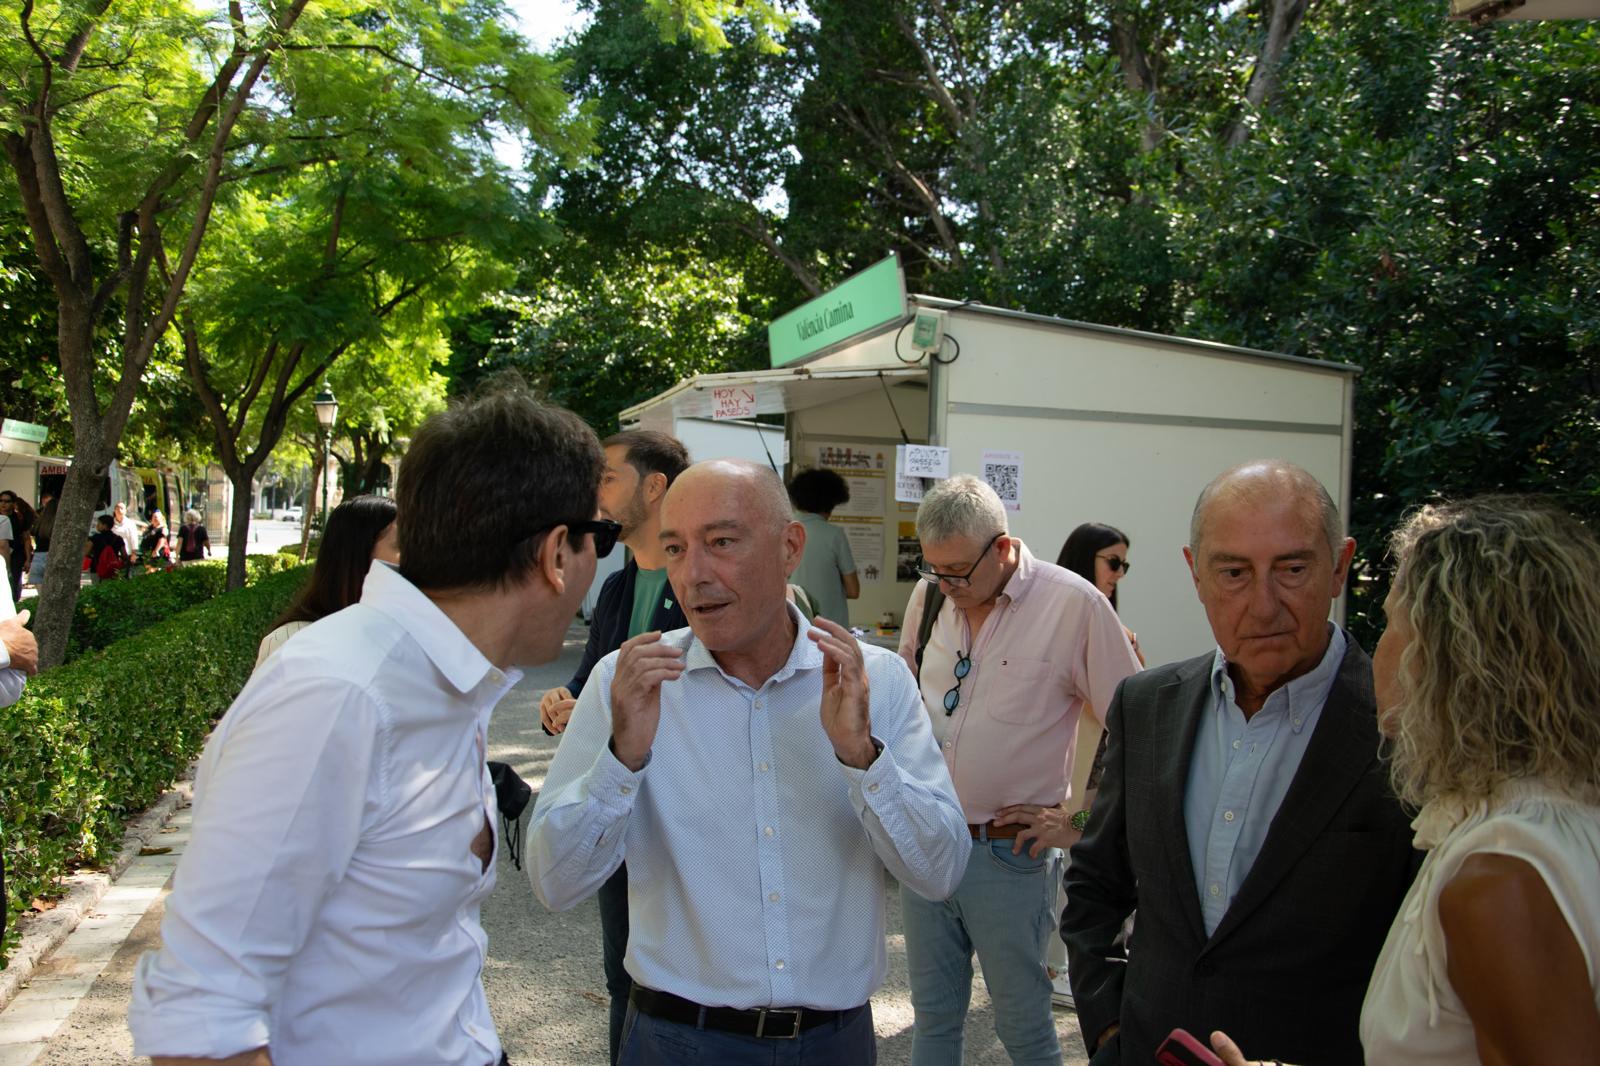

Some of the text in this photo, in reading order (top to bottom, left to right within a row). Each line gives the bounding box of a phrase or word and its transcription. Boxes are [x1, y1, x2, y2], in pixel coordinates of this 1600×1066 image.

[823, 301, 854, 330] Camina
[713, 388, 736, 399] HOY
[721, 398, 741, 408] HAY
[715, 407, 750, 417] PASEOS
